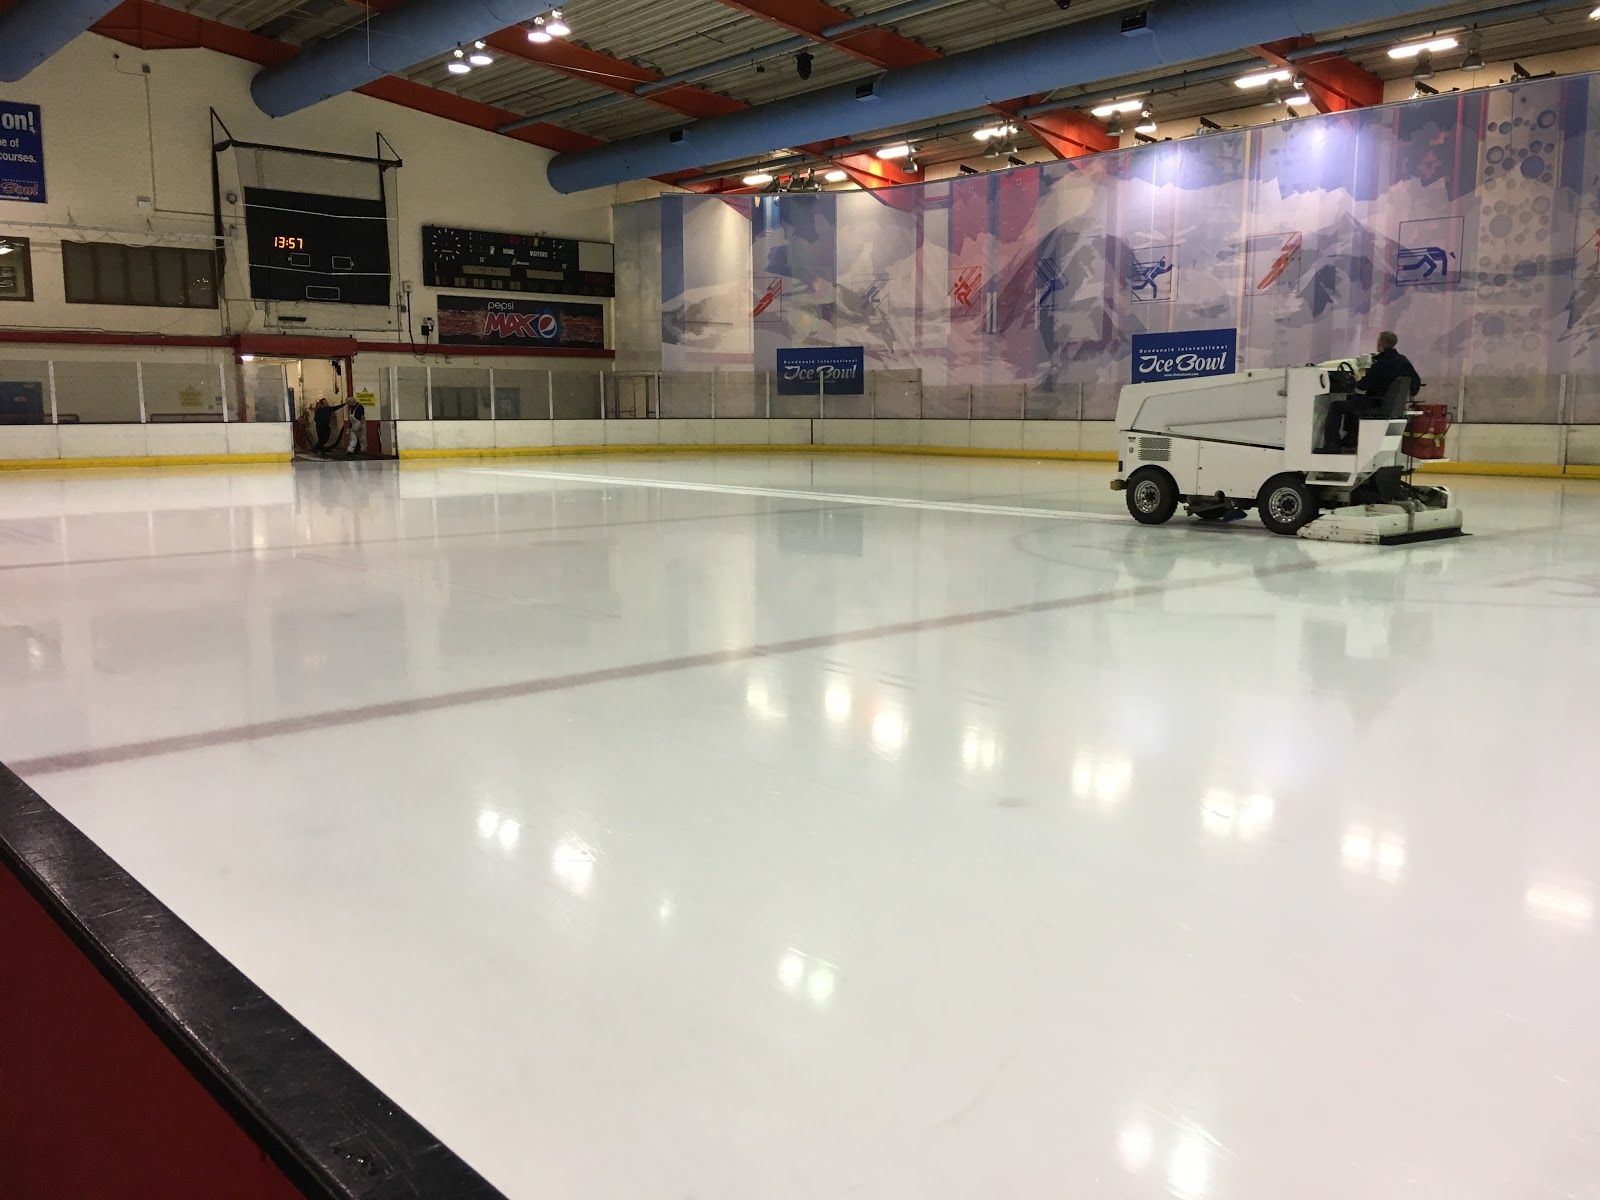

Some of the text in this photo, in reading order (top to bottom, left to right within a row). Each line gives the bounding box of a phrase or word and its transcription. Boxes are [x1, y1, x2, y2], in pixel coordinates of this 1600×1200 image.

[2, 111, 35, 133] on!
[9, 138, 19, 147] of
[274, 236, 303, 249] 13:57
[488, 301, 514, 311] pepsi
[484, 311, 540, 338] MAX
[1139, 352, 1227, 373] Ice Bowl
[784, 364, 857, 380] Ice Bowl
